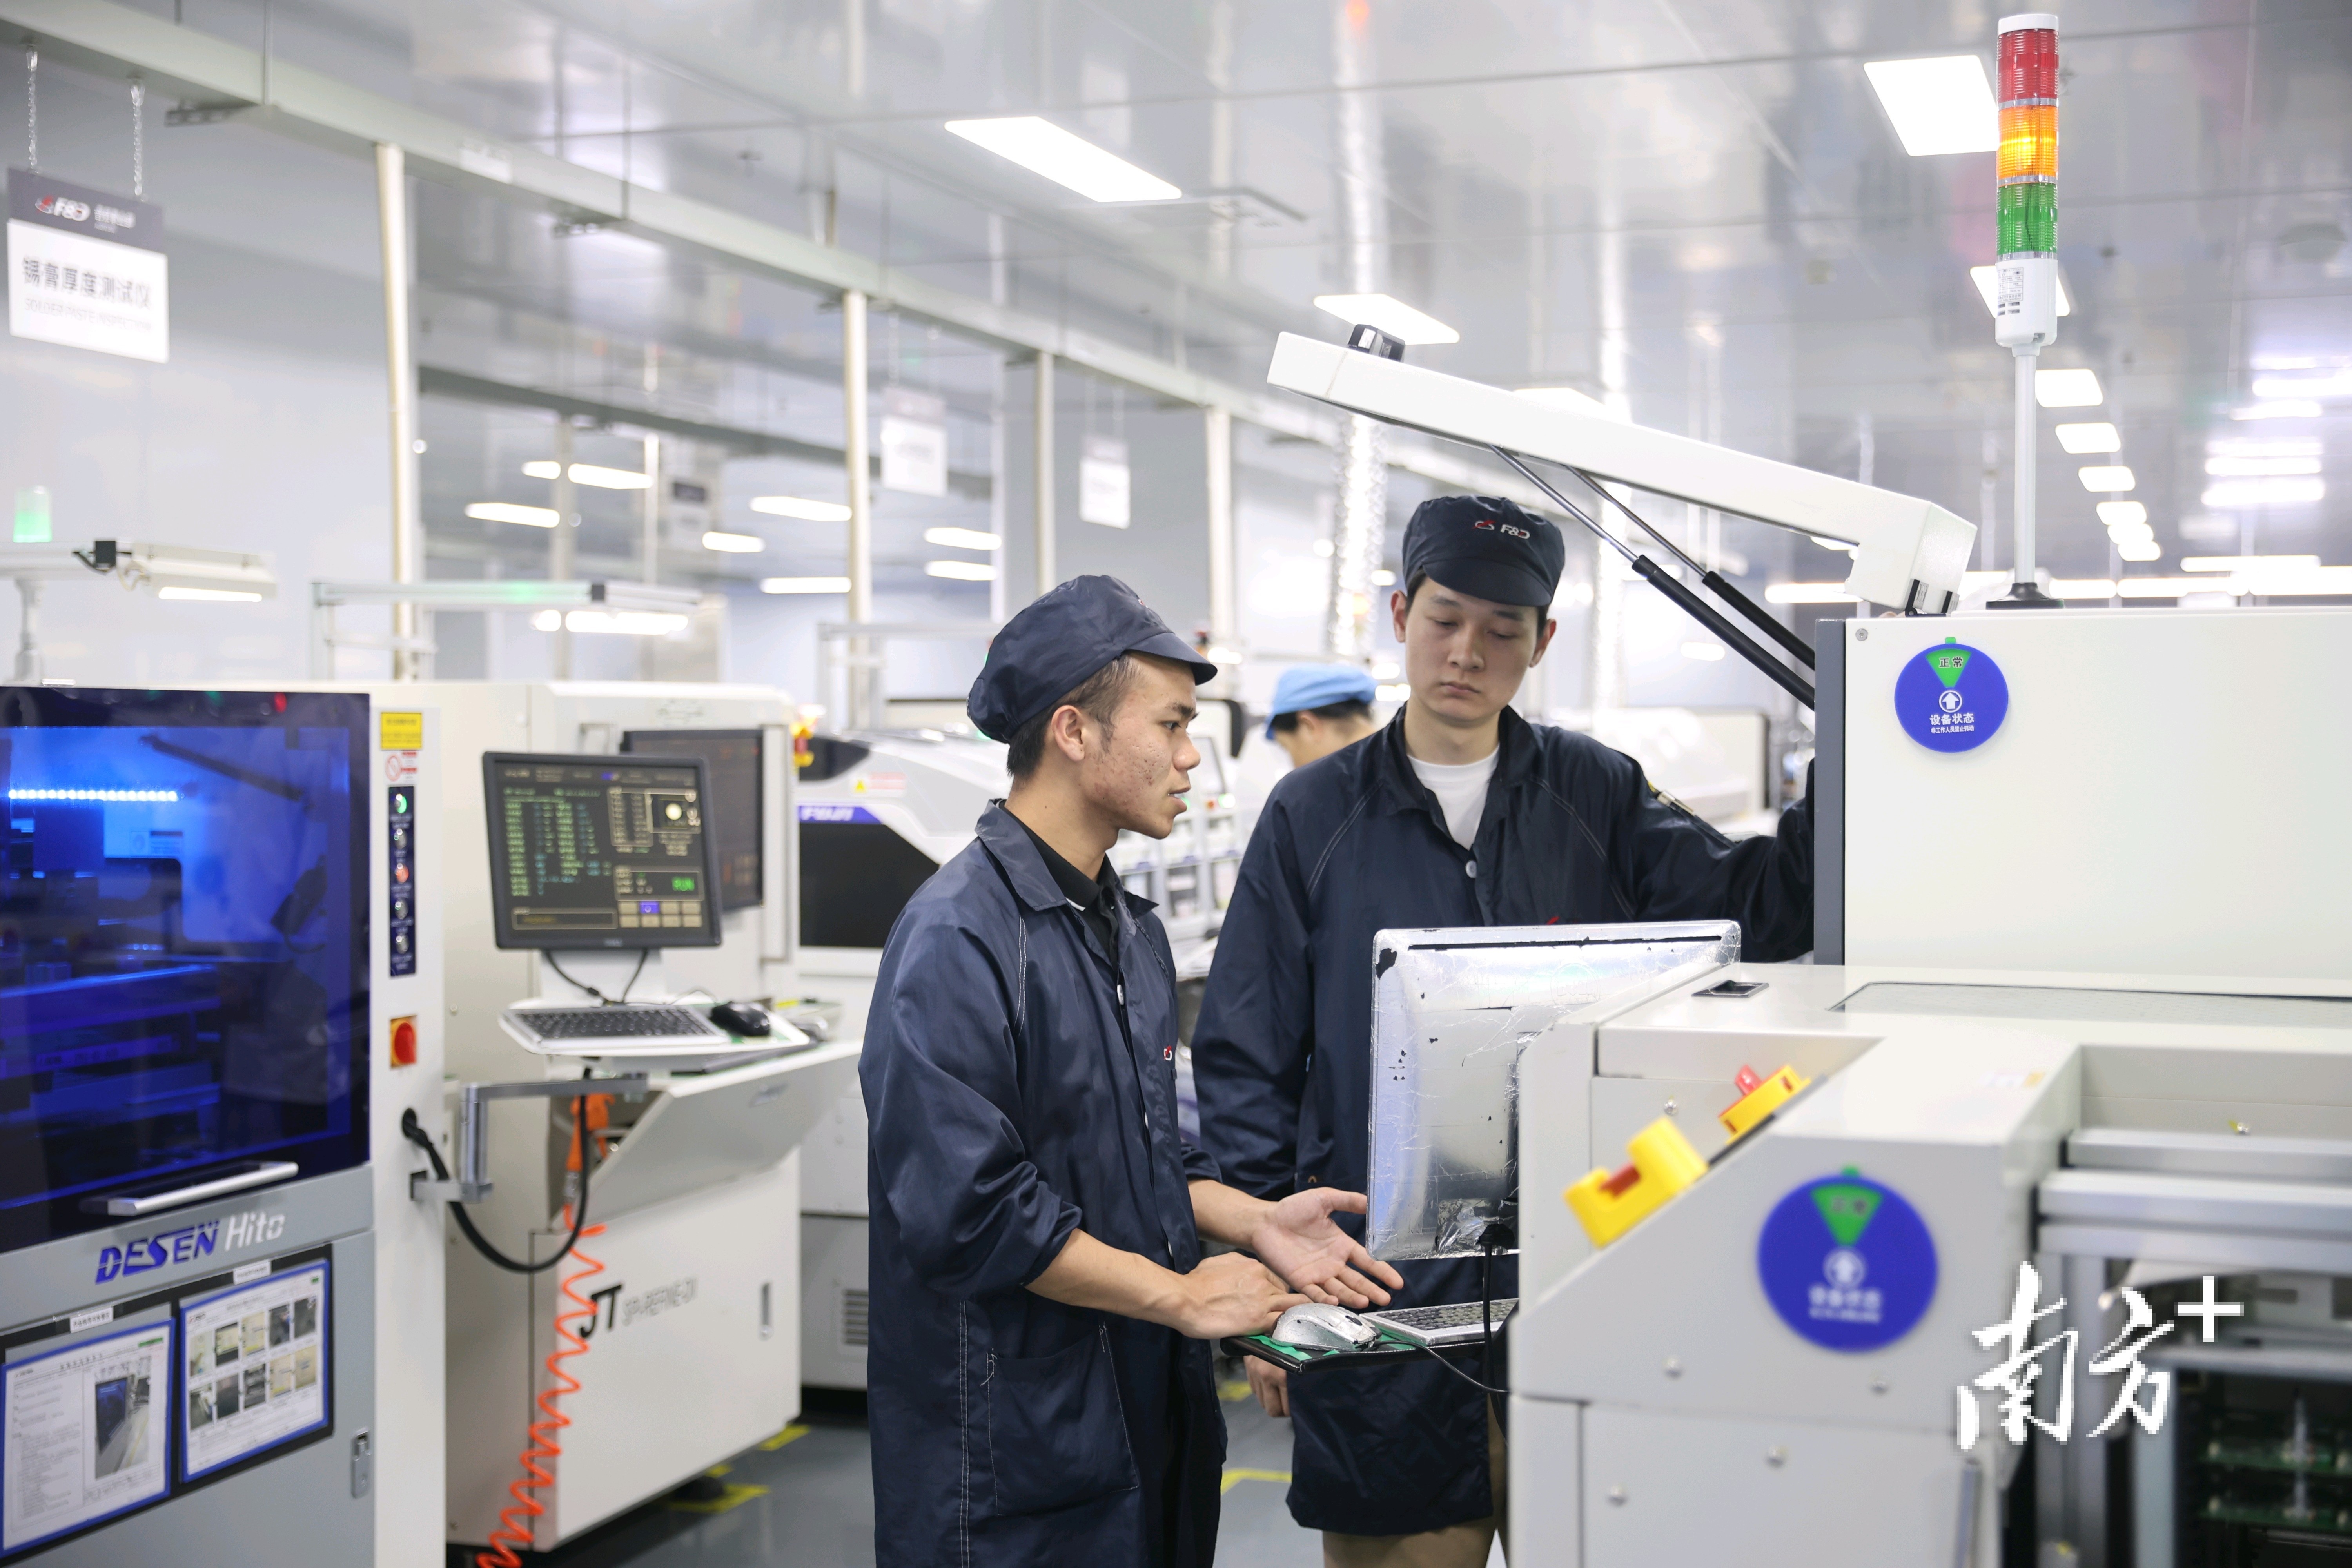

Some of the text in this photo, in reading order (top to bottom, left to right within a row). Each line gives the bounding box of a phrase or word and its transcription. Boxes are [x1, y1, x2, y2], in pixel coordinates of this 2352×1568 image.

[22, 256, 152, 310] 锡膏厚度测试仪
[25, 298, 63, 316] SOLDER
[1501, 524, 1530, 539] F&D
[1938, 657, 1963, 668] 正常
[1929, 713, 1975, 725] 设备状态
[1931, 725, 1974, 734] 非工作人员禁止转动
[95, 1211, 285, 1285] DESEN Hito
